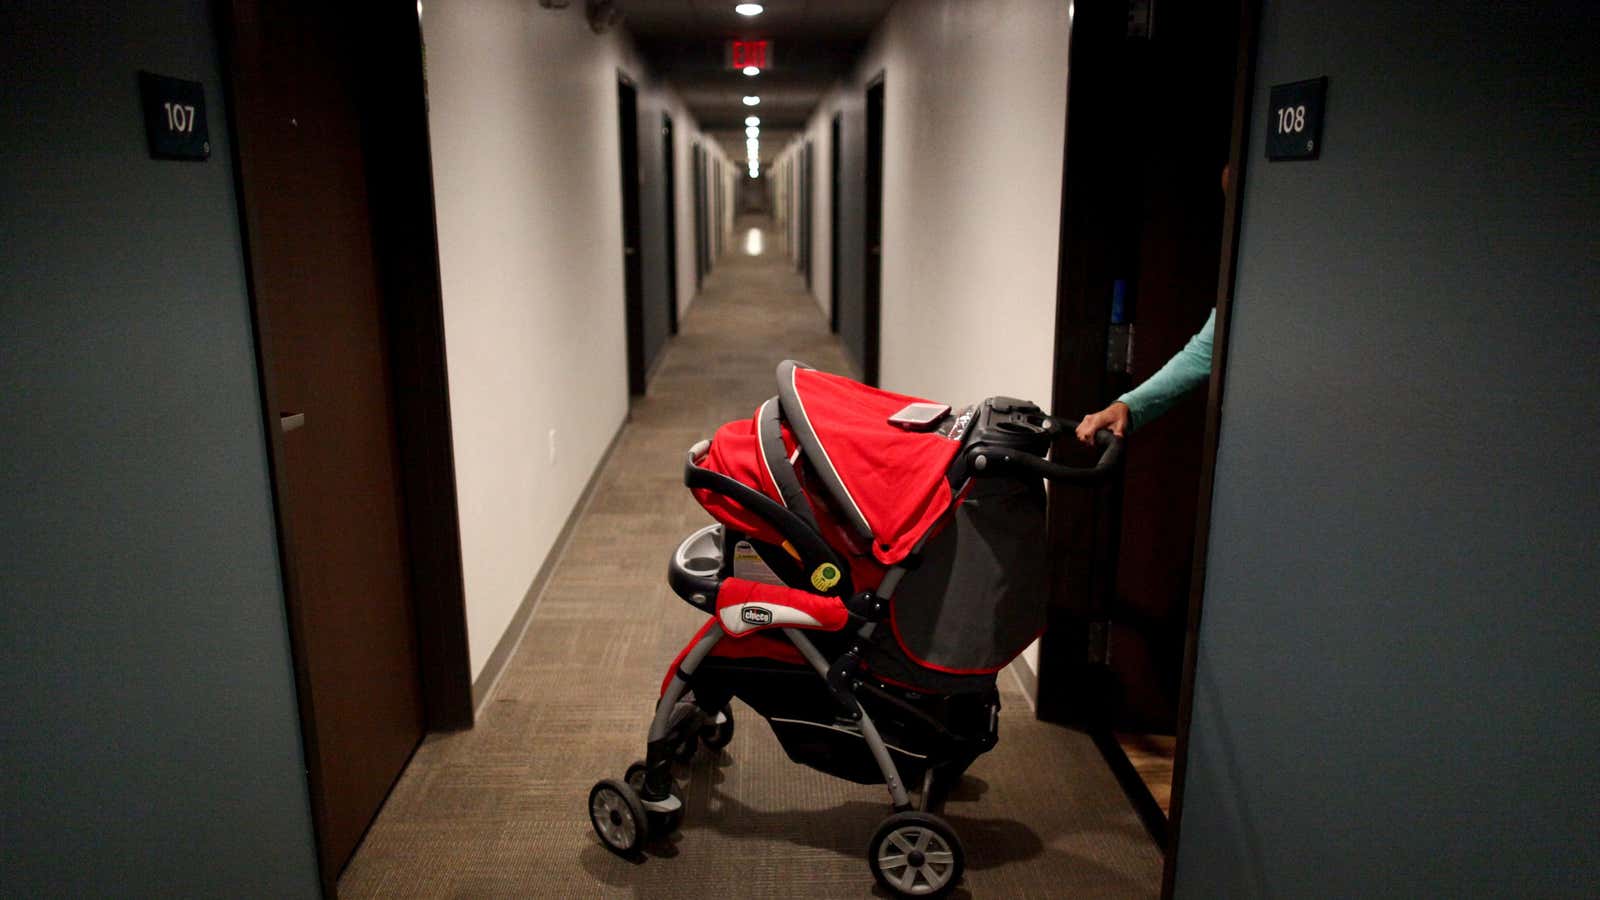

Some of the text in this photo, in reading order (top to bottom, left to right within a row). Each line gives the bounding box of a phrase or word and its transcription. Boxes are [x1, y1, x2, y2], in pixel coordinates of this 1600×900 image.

[733, 41, 767, 68] EXIT
[164, 102, 194, 132] 107
[1278, 105, 1305, 134] 108
